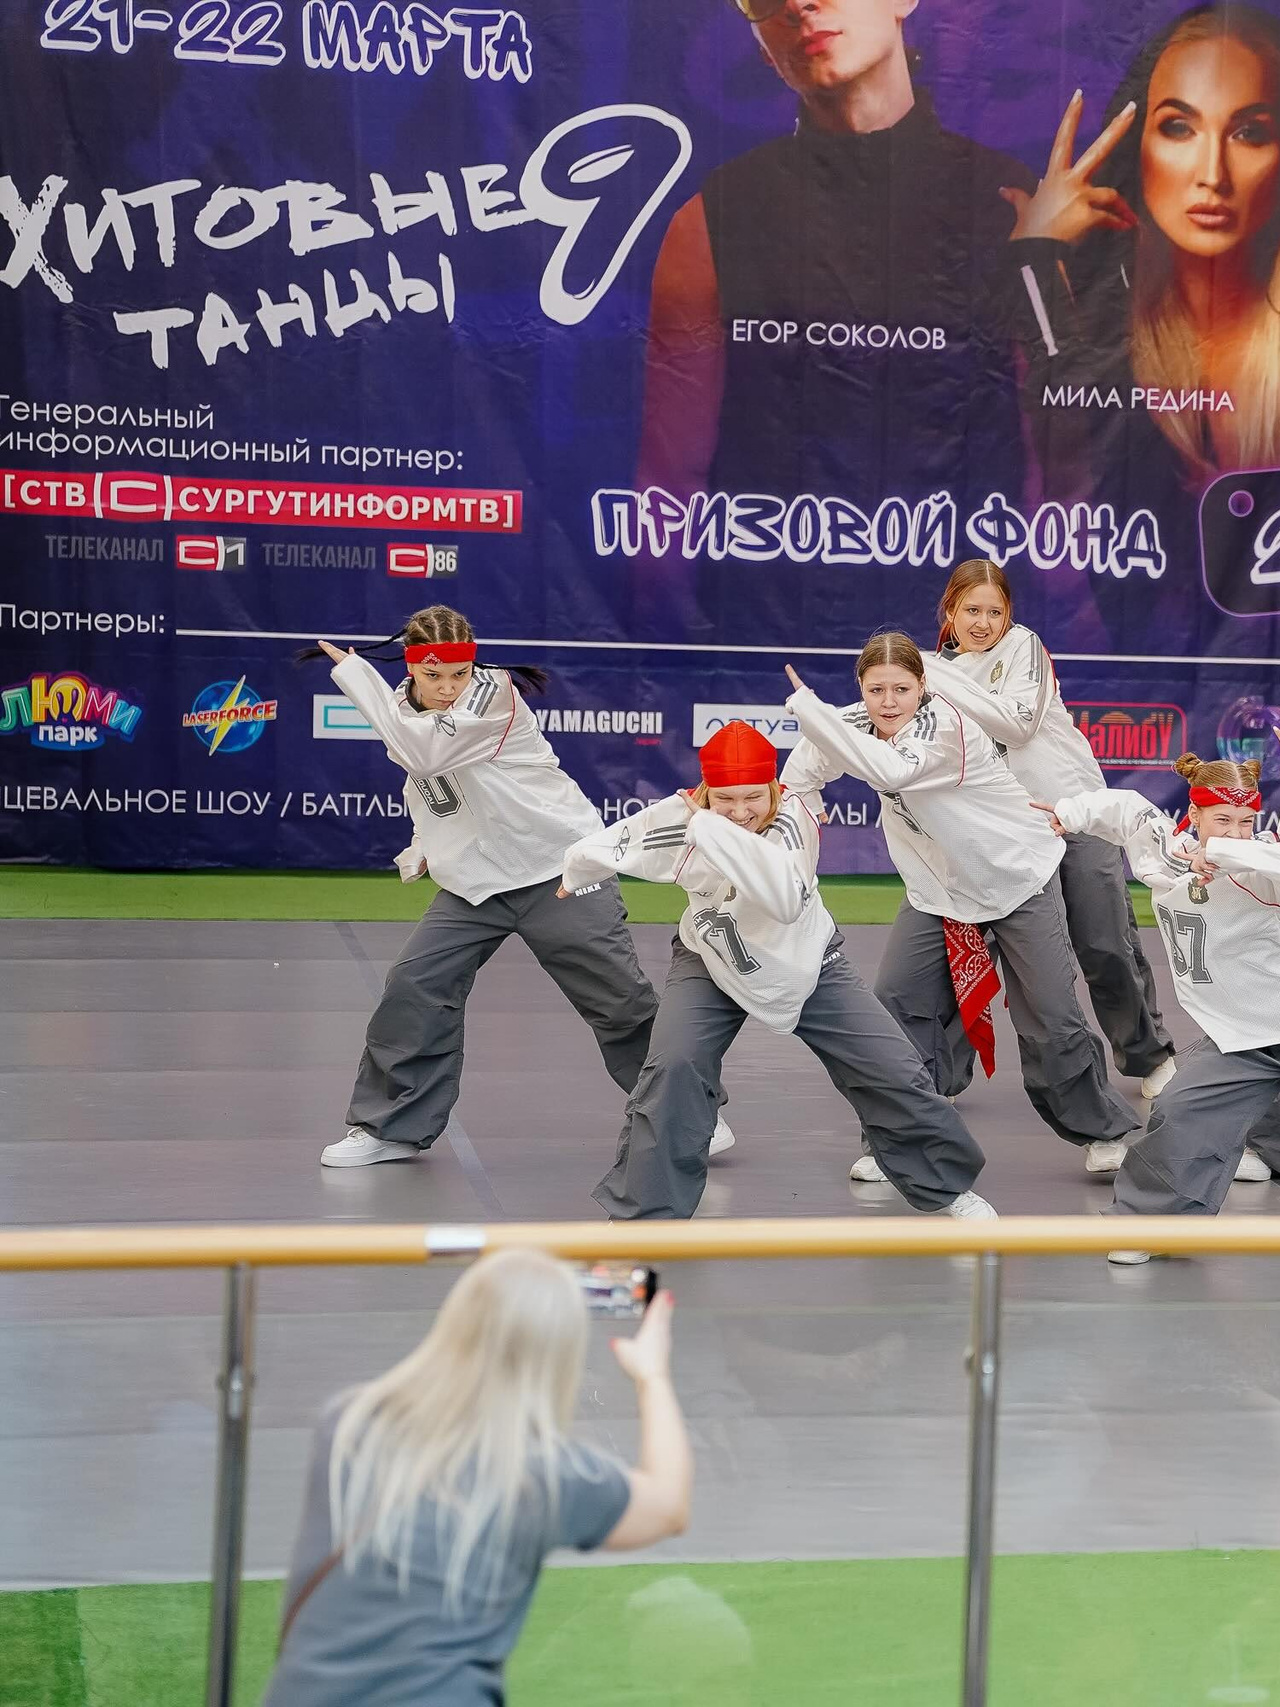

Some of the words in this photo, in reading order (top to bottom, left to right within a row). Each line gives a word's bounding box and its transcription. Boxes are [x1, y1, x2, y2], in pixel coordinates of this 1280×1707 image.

[302, 0, 532, 83] МАРТА
[0, 164, 522, 303] ХИТОВЫЕ
[113, 251, 455, 369] ТАНЦЫ
[732, 319, 797, 344] ЕГОР
[806, 321, 946, 350] СОКОЛОВ
[1042, 385, 1122, 409] МИЛА
[1130, 387, 1234, 413] РЕДИНА
[321, 443, 464, 474] партнер:
[591, 485, 956, 567] ПРИЗОВОЙ
[965, 493, 1167, 579] ФОНД
[45, 535, 164, 561] ТЕЛЕКАНАЛ
[262, 544, 376, 571] ТЕЛЕКАНАЛ
[0, 603, 165, 638] Партнеры:
[183, 700, 278, 728] LASERFORCE
[535, 709, 663, 735] YAMAGUCHI
[38, 725, 98, 747] парк
[4, 785, 187, 814] ЦЕВАЛЬНОЕ
[196, 790, 271, 816] ШОУ
[302, 792, 409, 818] БАТТЛЫ
